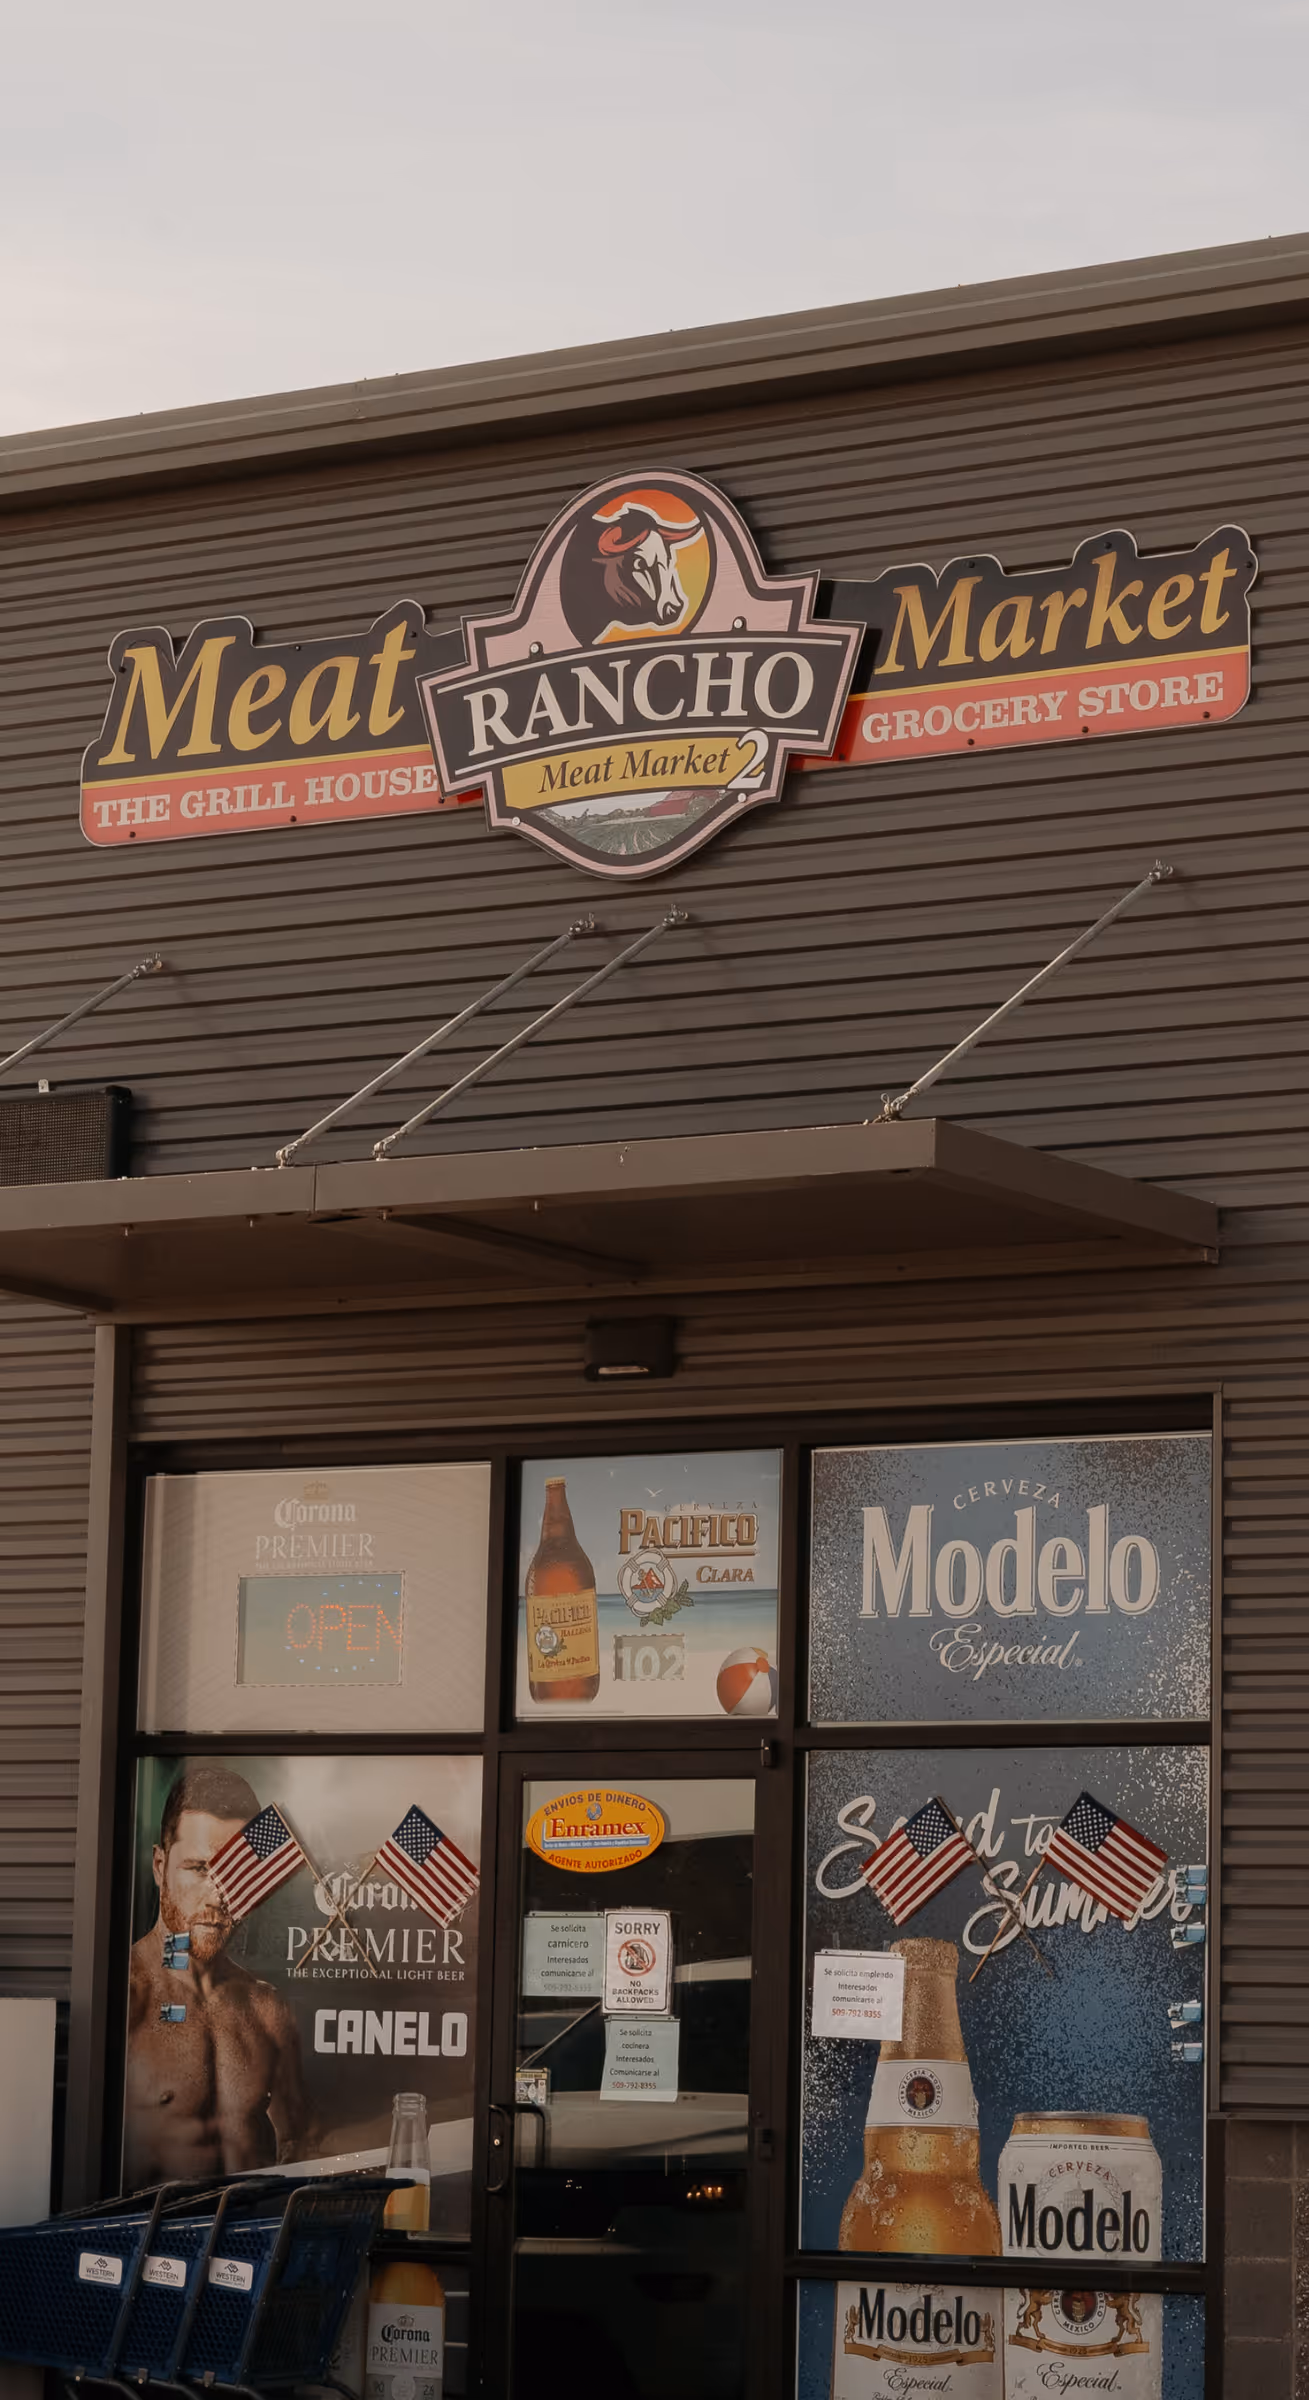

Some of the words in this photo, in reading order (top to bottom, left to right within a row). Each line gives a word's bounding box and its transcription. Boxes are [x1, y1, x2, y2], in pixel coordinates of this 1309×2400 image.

[873, 546, 1239, 676] Market
[98, 619, 417, 767] Meat
[463, 650, 815, 757] RANCHO
[861, 690, 1068, 744] GROCERY
[1078, 671, 1225, 720] STORE
[537, 760, 614, 793] Meat
[619, 746, 731, 781] Market
[726, 730, 769, 789] 2
[93, 793, 171, 829] THE
[180, 781, 296, 820] GRILL
[304, 764, 438, 807] HOUSE
[953, 1478, 1062, 1511] CERVEZA
[274, 1498, 357, 1531] Corona
[618, 1508, 759, 1555] PACIFICO
[256, 1533, 375, 1559] PREMIER
[859, 1503, 1161, 1619] Modelo
[696, 1565, 755, 1584] CLARA
[287, 1603, 402, 1651] OPEN
[929, 1622, 1080, 1681] Especial
[618, 1645, 686, 1681] 102
[544, 1794, 584, 1816] ENVIOS
[588, 1792, 602, 1802] DE
[605, 1793, 646, 1812] DINERO
[550, 1818, 647, 1838] Enramex
[548, 1853, 582, 1869] AGENTE
[584, 1849, 643, 1869] AUTORIZADO
[550, 1924, 560, 1933] Se
[561, 1924, 587, 1933] solicita
[614, 1922, 661, 1936] SORRY
[287, 1926, 465, 1965] PREMIER
[547, 1938, 589, 1949] carnicero
[546, 1956, 589, 1965] Interesados
[286, 1968, 309, 1978] THE
[312, 1968, 393, 1981] EXCEPTIONAL
[397, 1969, 433, 1981] LIGHT
[437, 1970, 466, 1982] BEER
[629, 1980, 641, 1988] NO
[611, 1988, 660, 1996] BACKPACKS
[837, 1982, 878, 1992] Interesados
[615, 1995, 655, 2004] ALLOWED
[831, 2008, 882, 2019] 509-792-8355
[314, 2008, 469, 2057] CANELO
[621, 2041, 650, 2050] cocinera
[615, 2055, 655, 2064] Interesados
[609, 2068, 653, 2077] Comunicarse
[1049, 2143, 1088, 2151] IMPORTED
[1048, 2160, 1112, 2181] CERVEZA
[1008, 2182, 1150, 2254] Modelo
[85, 2266, 116, 2279] WESTERN
[149, 2267, 179, 2281] WESTERN
[215, 2271, 247, 2284] WESTERN
[857, 2287, 981, 2346] Modelo
[1062, 2320, 1096, 2334] MEXICO
[381, 2322, 431, 2345] Corona
[372, 2346, 439, 2366] PREMIER
[882, 2367, 952, 2396] Especial
[1036, 2361, 1116, 2397] Especial
